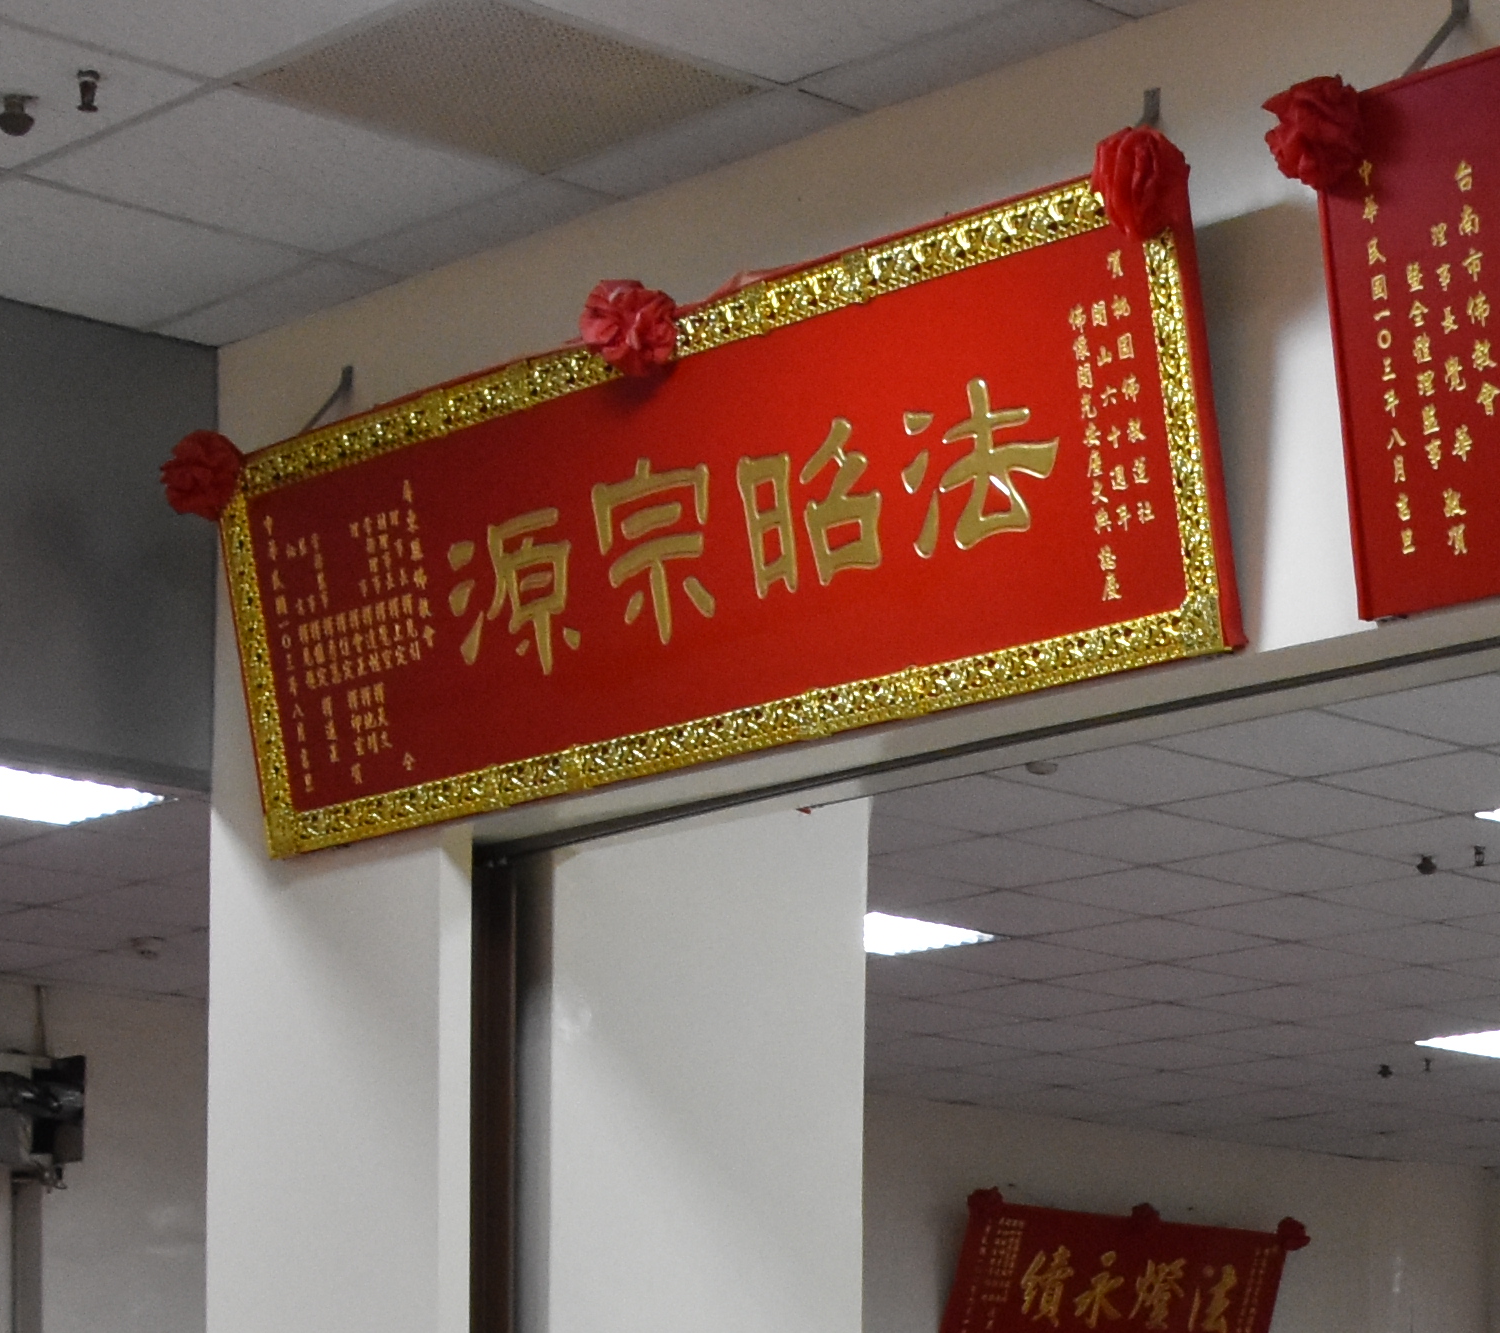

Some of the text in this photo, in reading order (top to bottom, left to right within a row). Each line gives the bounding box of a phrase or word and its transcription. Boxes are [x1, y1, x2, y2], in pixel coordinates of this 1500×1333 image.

[1454, 159, 1500, 416] 台南市佛教會
